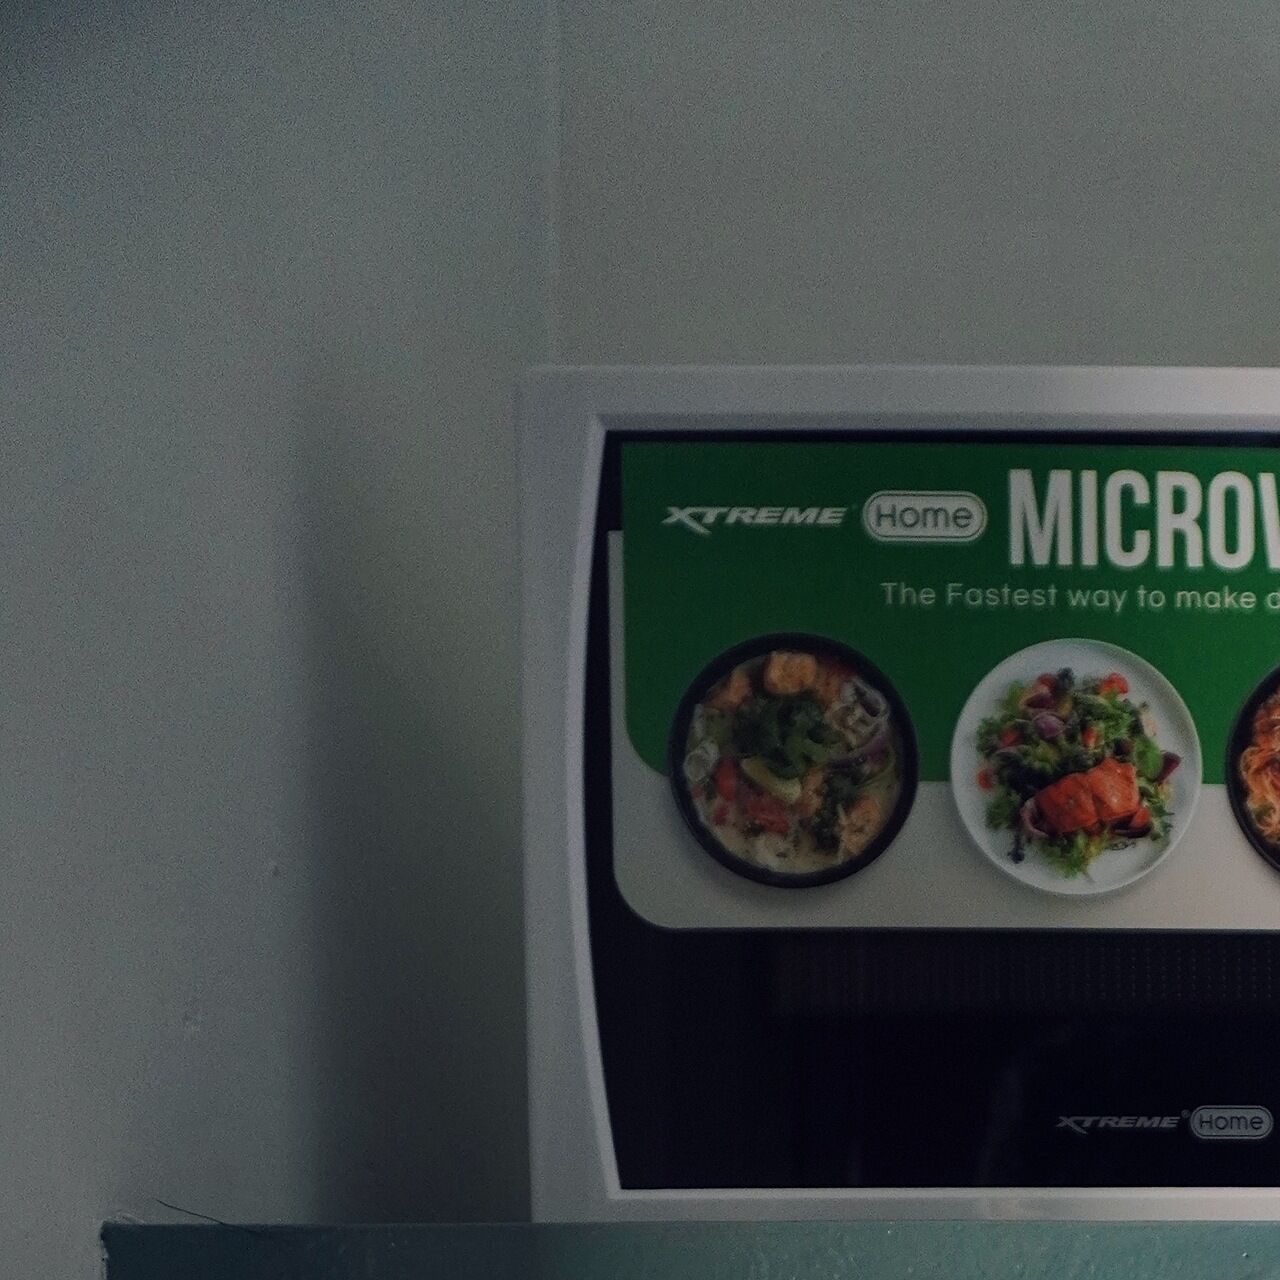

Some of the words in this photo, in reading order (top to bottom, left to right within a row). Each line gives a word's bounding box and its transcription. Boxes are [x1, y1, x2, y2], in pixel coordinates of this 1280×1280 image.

[661, 505, 849, 536] XTREME
[875, 504, 974, 529] Home
[881, 582, 937, 606] The
[945, 582, 1058, 607] Fastest
[1067, 588, 1128, 616] way
[1137, 585, 1166, 610] to
[1175, 586, 1258, 610] make
[1055, 1115, 1181, 1135] XTREME
[1200, 1112, 1265, 1131] Home
